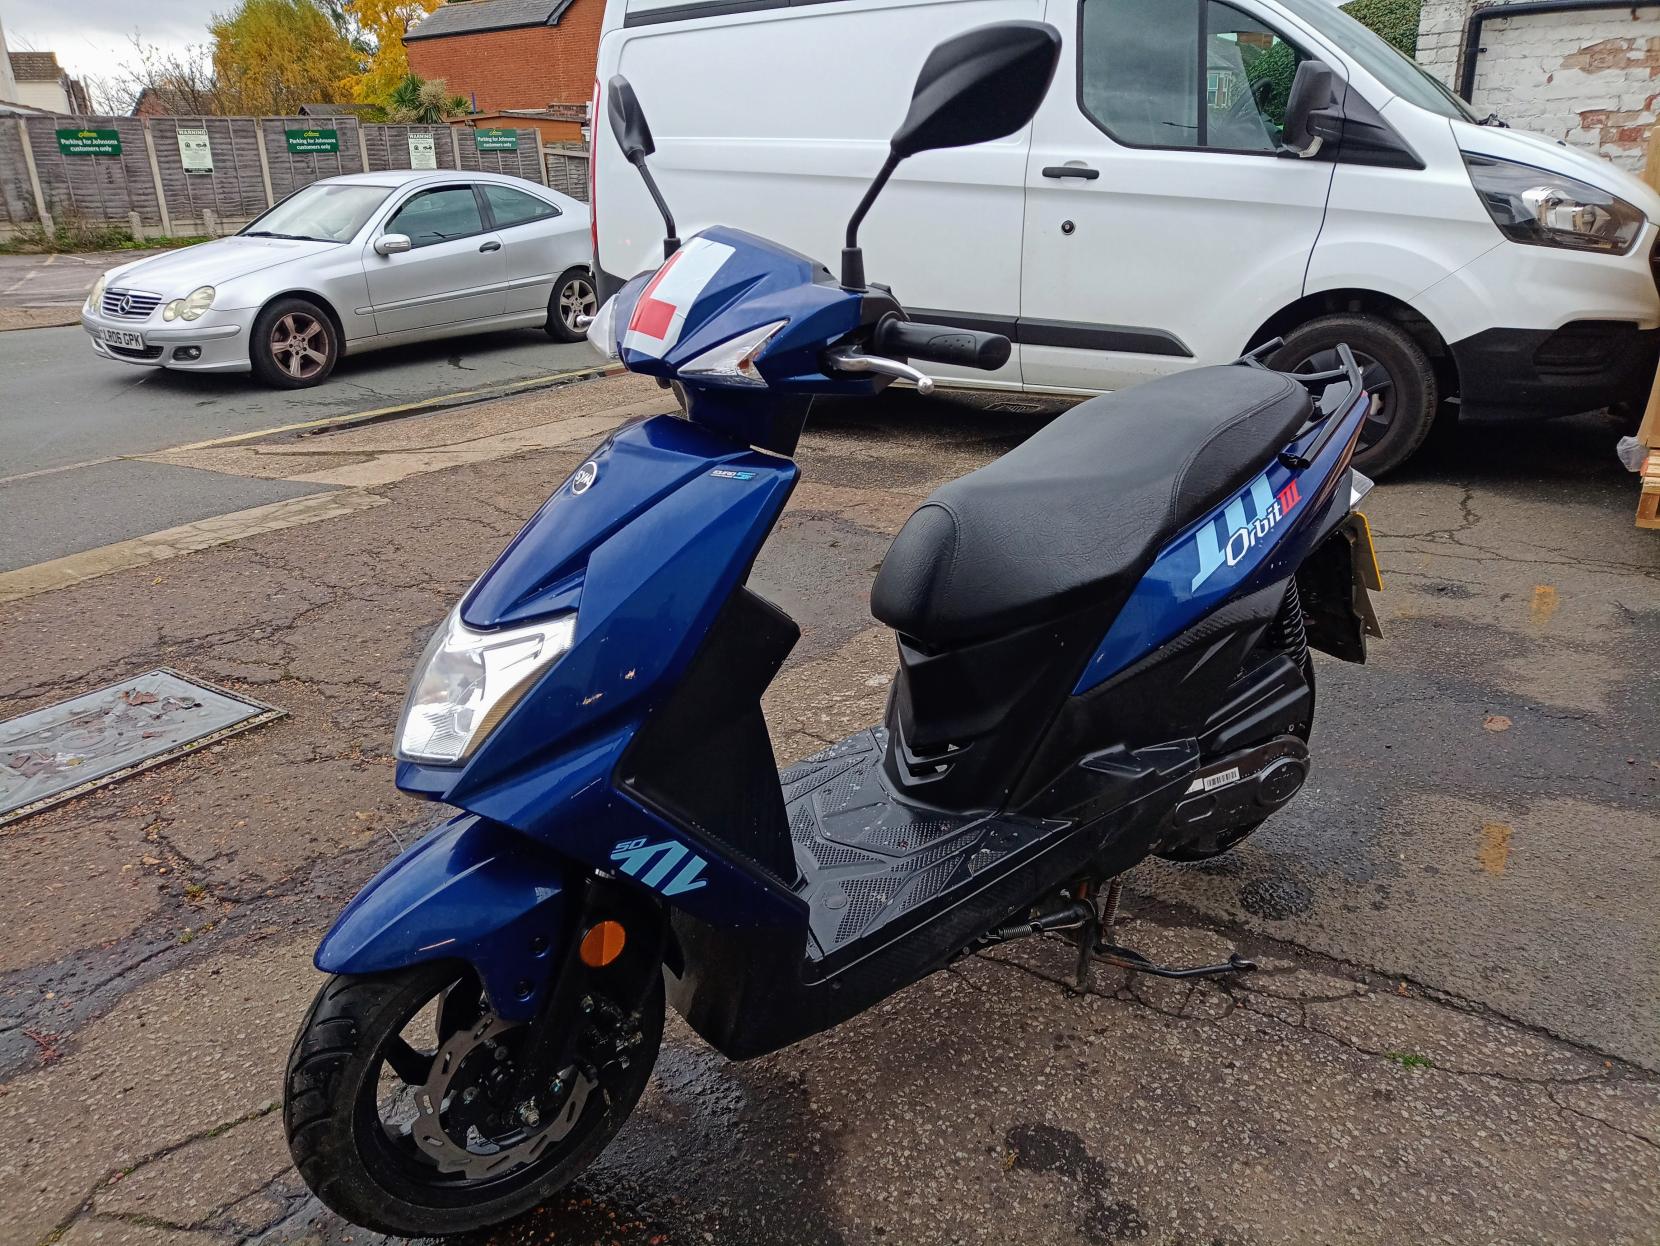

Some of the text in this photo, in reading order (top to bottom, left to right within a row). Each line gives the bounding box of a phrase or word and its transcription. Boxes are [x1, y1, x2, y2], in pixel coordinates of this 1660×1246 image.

[104, 329, 141, 347] LR06 GPK
[575, 470, 592, 485] SYM
[612, 838, 647, 853] 50
